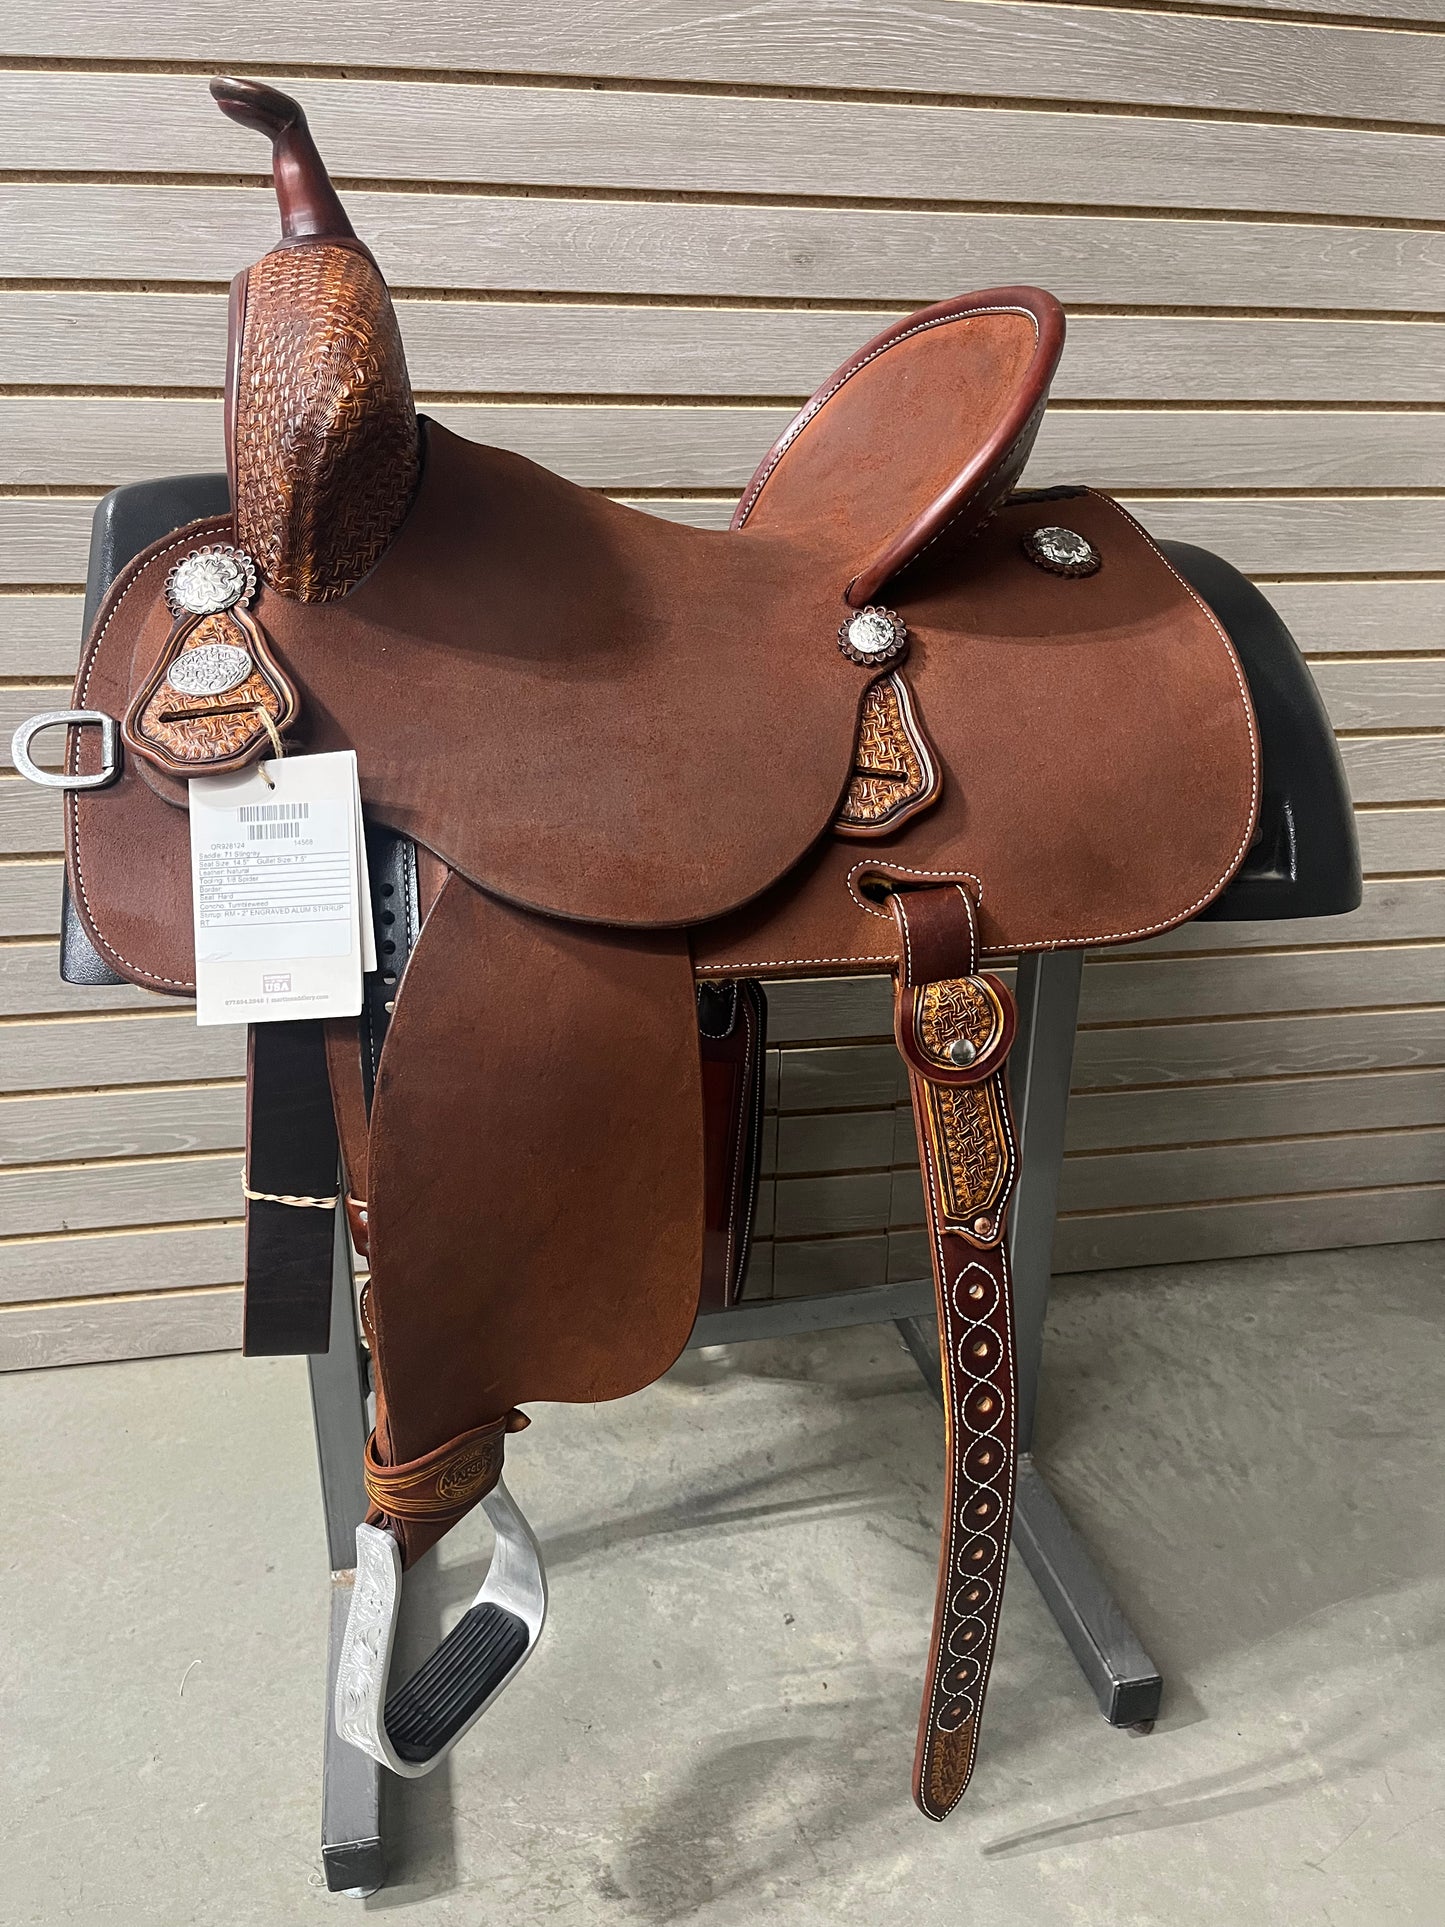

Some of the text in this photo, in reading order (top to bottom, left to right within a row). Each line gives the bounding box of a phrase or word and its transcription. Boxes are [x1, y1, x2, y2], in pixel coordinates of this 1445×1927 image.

[250, 906, 290, 916] ENGRAVED
[291, 905, 311, 913] ALUM
[312, 904, 344, 913] STIRRUP
[264, 982, 289, 992] USA
